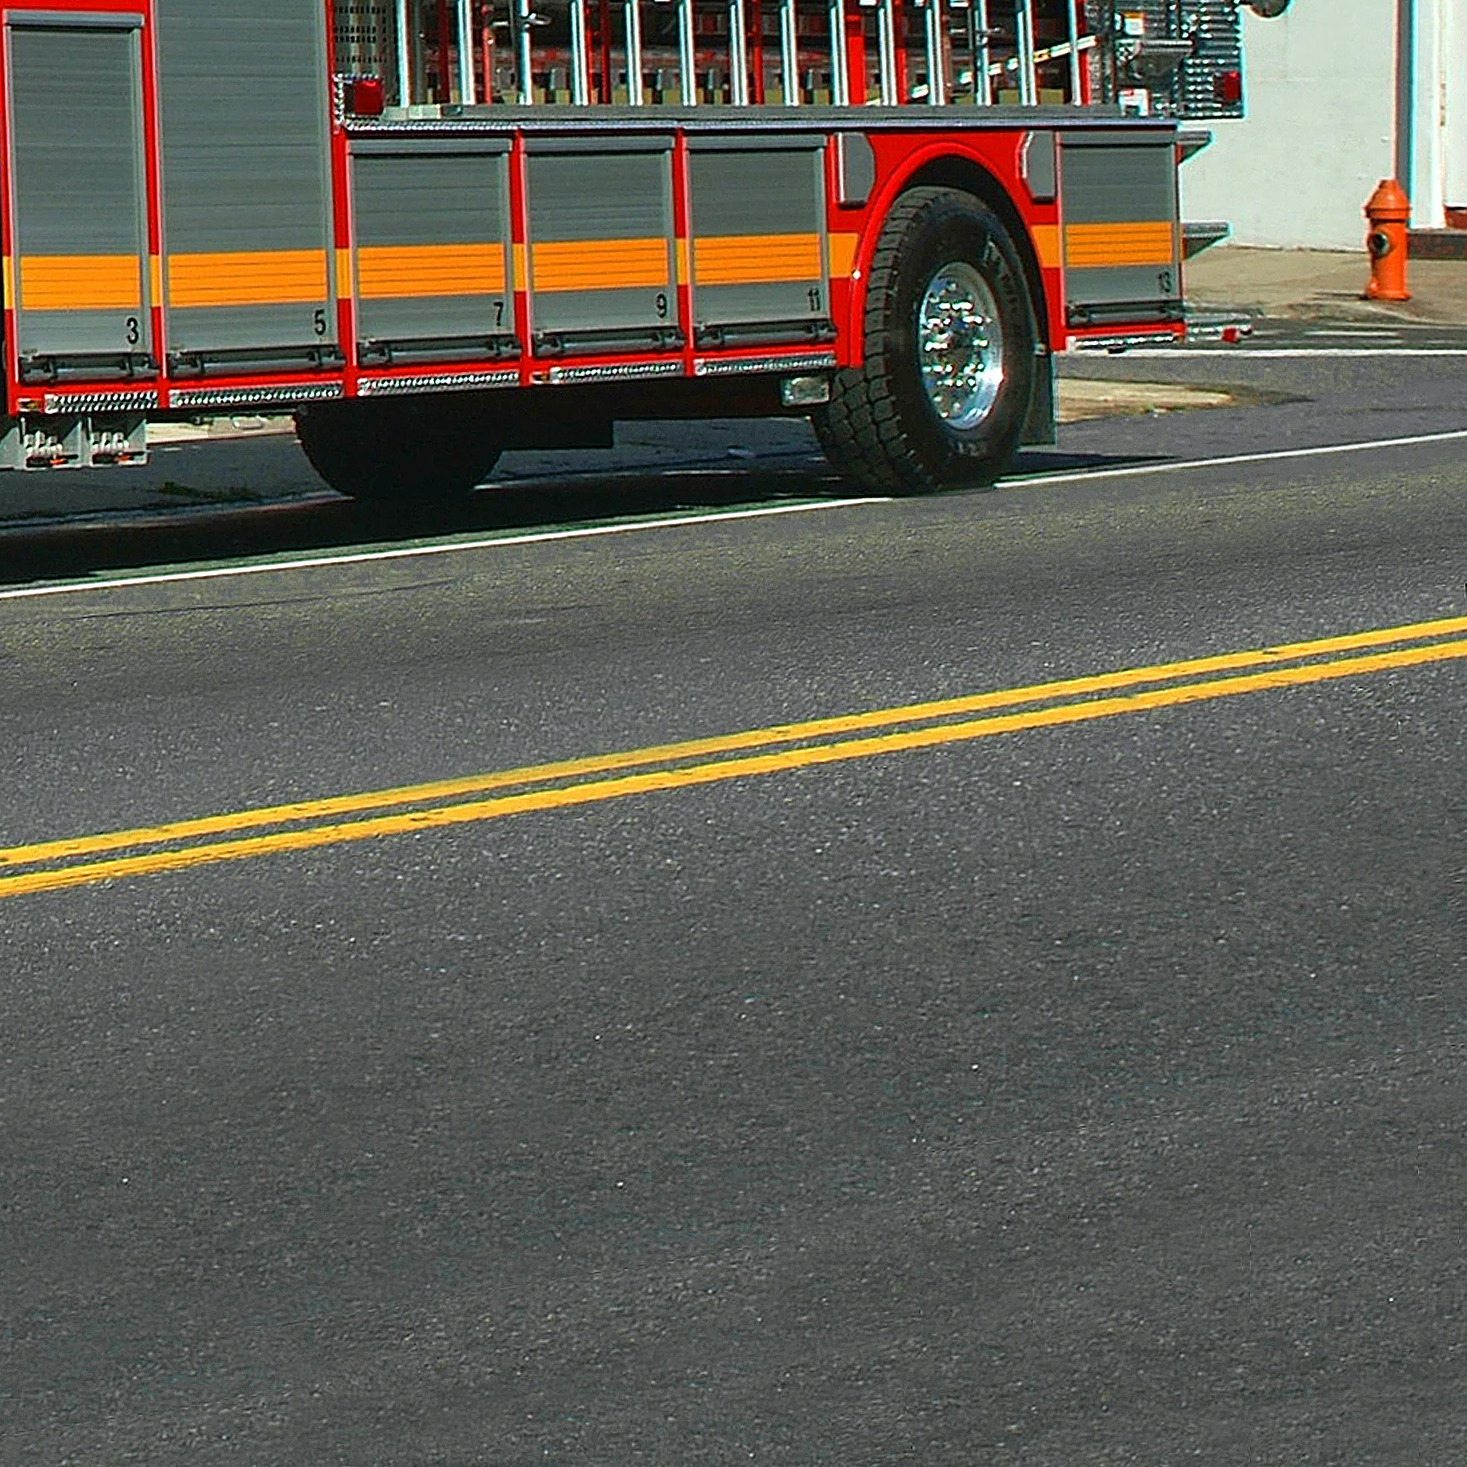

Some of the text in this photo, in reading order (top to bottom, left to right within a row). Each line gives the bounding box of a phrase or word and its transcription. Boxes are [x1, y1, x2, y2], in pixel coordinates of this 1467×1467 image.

[1157, 271, 1172, 294] 13
[657, 293, 668, 318] 9
[808, 288, 821, 311] 11
[314, 309, 327, 336] 5
[493, 302, 504, 326] 7
[127, 317, 139, 345] 3
